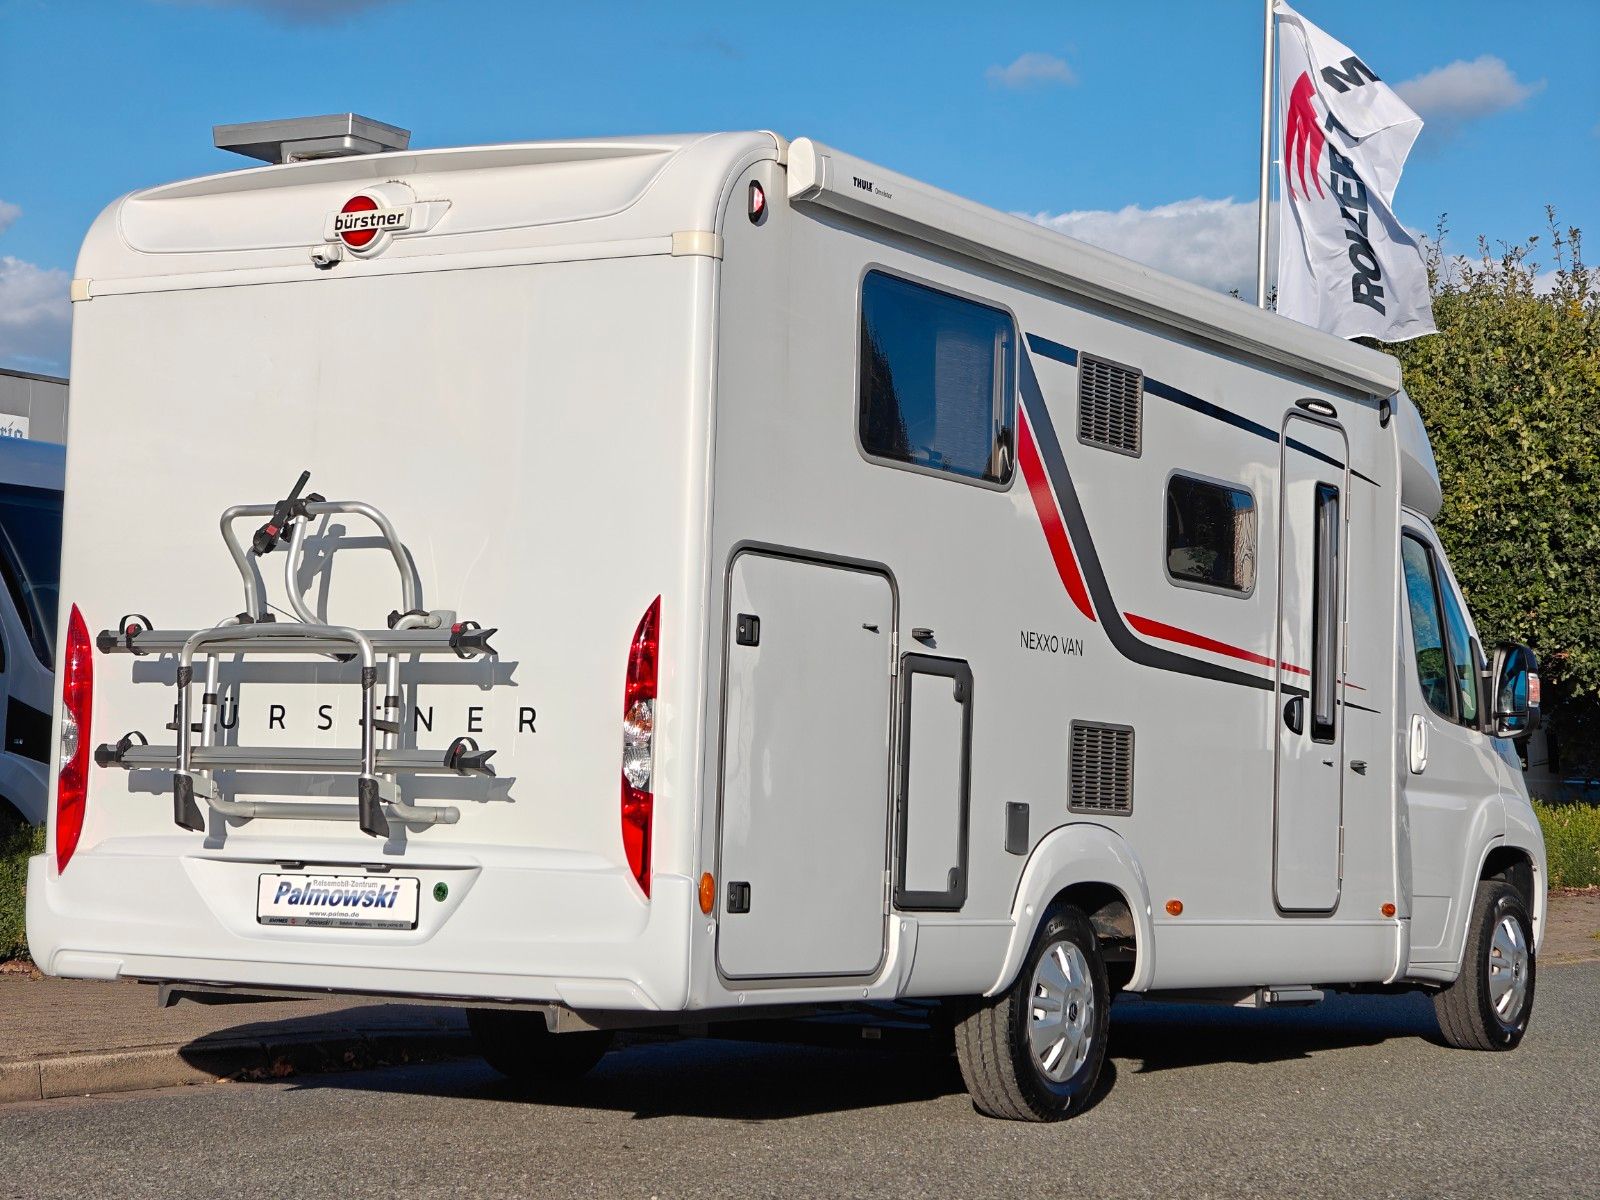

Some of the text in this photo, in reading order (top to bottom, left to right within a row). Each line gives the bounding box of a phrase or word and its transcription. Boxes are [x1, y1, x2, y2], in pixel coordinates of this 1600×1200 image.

[853, 176, 873, 193] THULE
[334, 212, 405, 231] bürstner
[1020, 630, 1084, 657] NEXXO VAN
[174, 697, 537, 733] ÜRSNER
[273, 881, 401, 909] Palmowski
